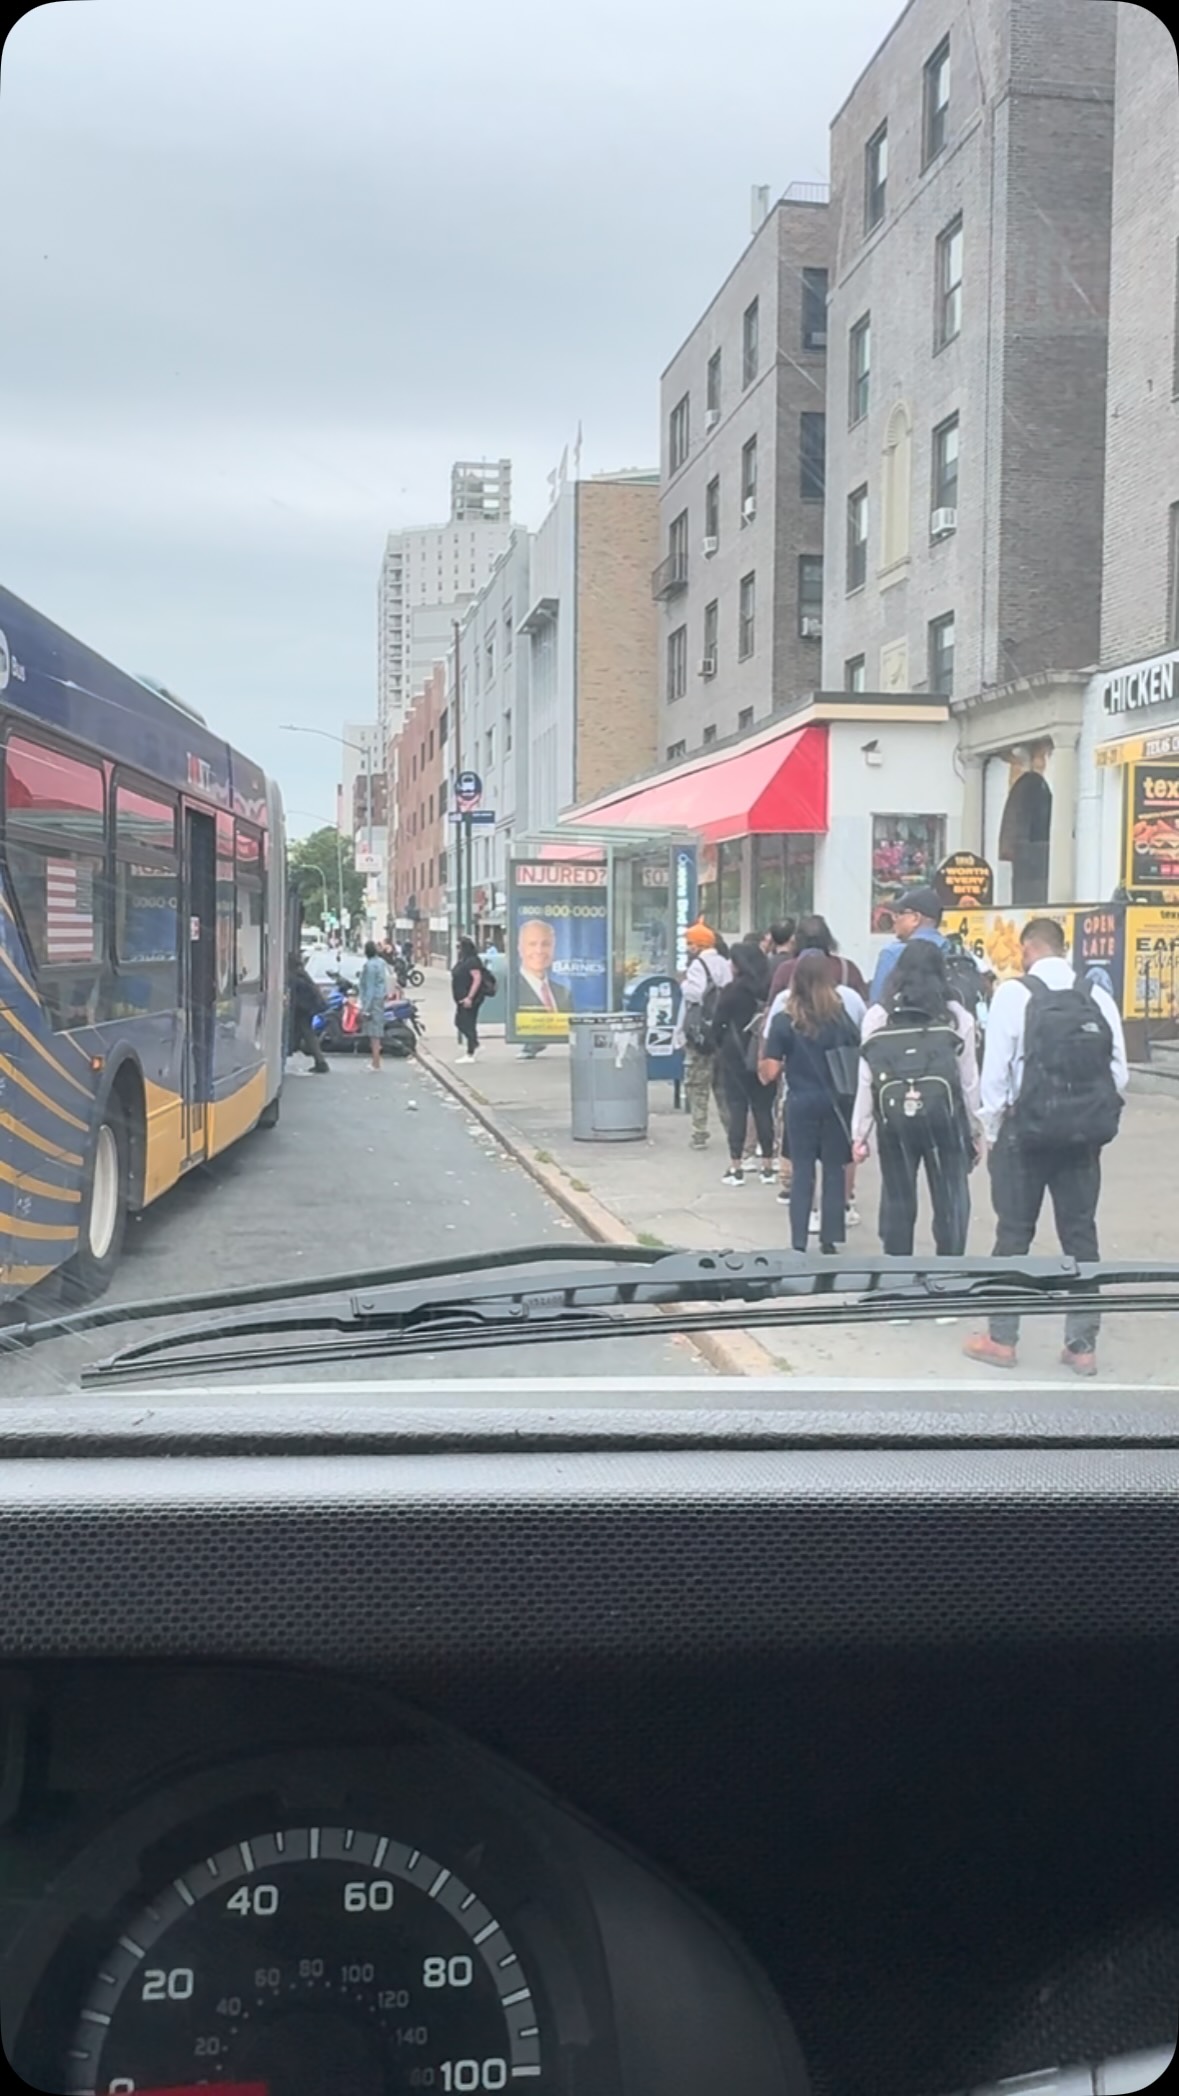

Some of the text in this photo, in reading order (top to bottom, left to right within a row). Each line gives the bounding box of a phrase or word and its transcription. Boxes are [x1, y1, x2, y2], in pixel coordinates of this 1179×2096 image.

[1103, 661, 1174, 715] CHICKEN
[516, 867, 607, 885] INJURED?
[1083, 914, 1116, 934] OPEN
[1082, 937, 1116, 957] LATE
[226, 1884, 279, 1916] 40
[343, 1881, 394, 1912] 60
[254, 1967, 281, 1987] 60
[300, 1958, 324, 1979] 80
[341, 1963, 374, 1984] 100
[423, 1955, 474, 1988] 80
[142, 1967, 194, 2000] 20
[216, 1997, 242, 2017] 40
[378, 1989, 410, 2009] 120
[194, 2037, 220, 2056] 20
[440, 2057, 507, 2092] 100
